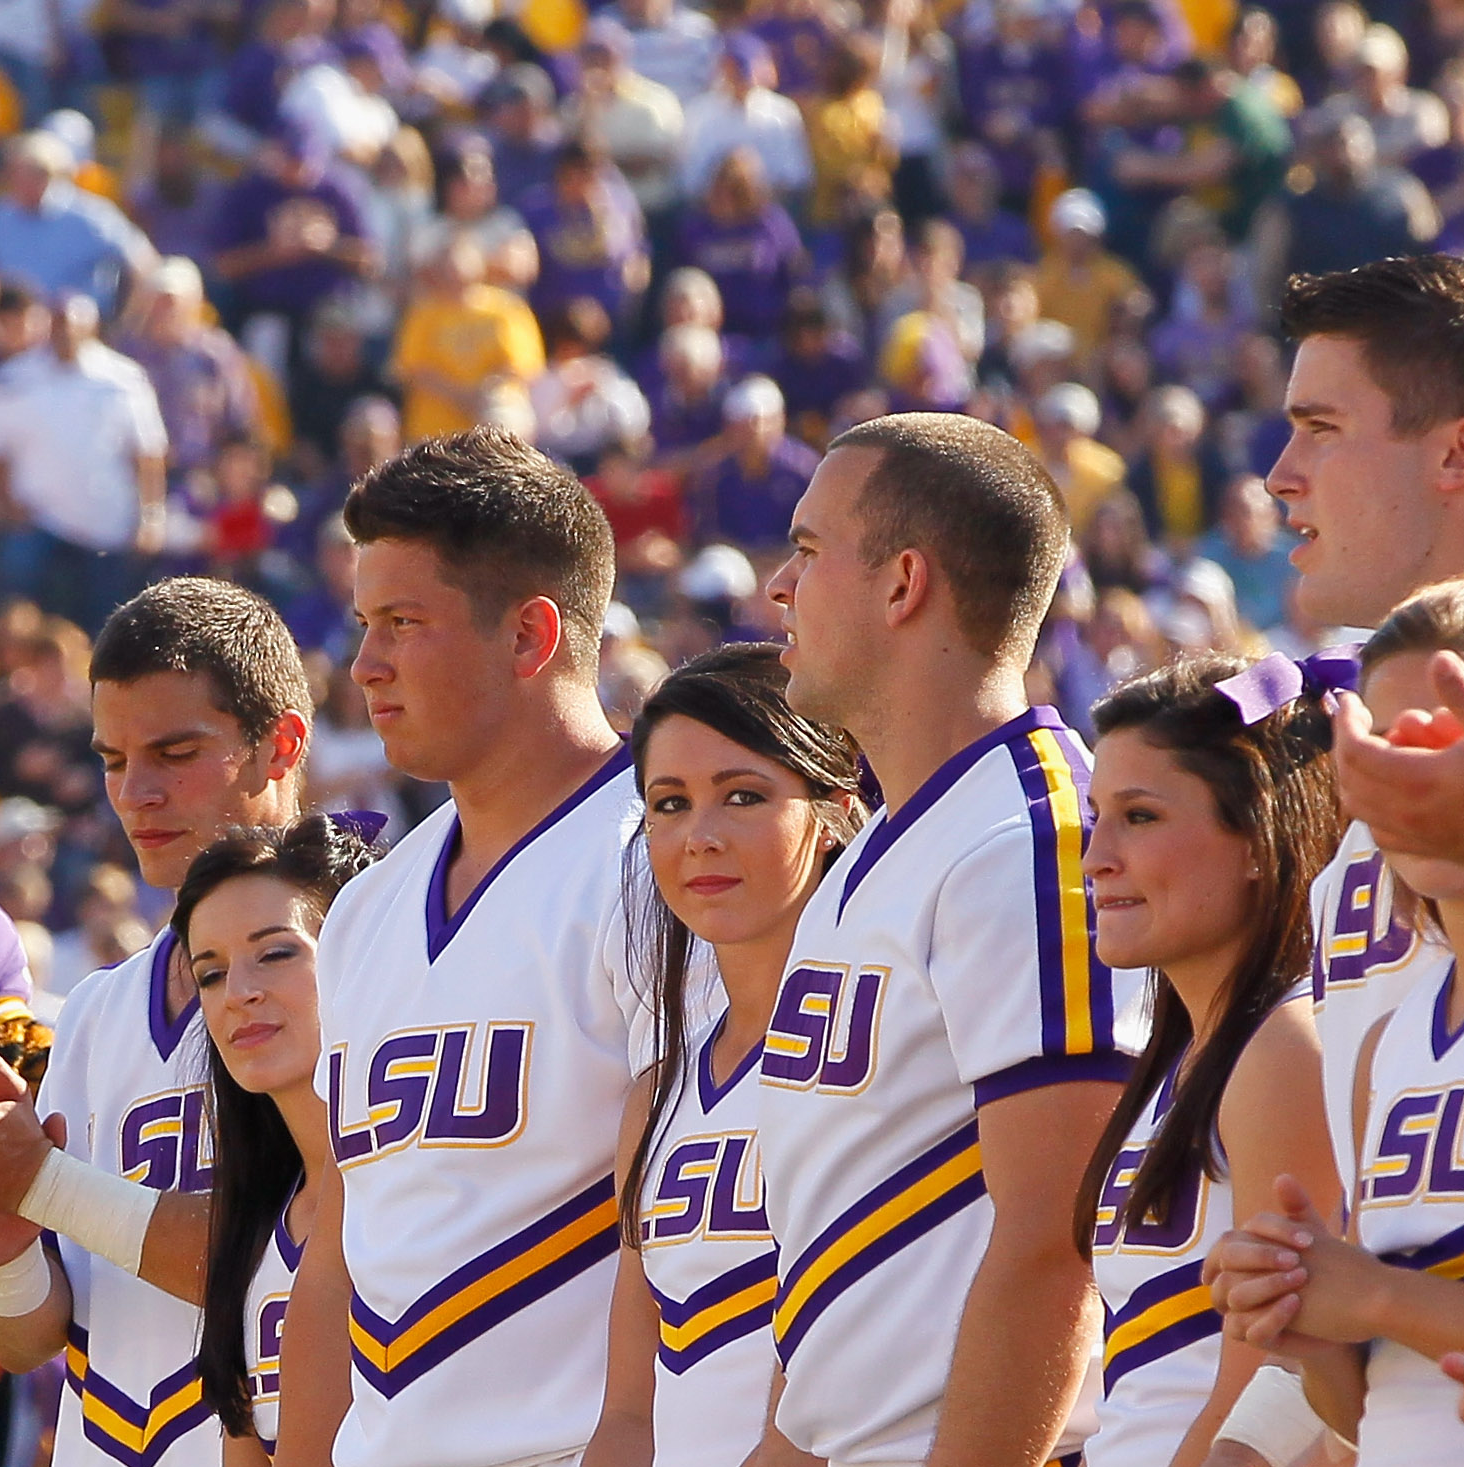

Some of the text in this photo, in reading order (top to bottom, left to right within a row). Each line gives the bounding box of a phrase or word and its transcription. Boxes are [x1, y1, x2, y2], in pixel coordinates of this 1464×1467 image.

[1313, 848, 1425, 1016] SU
[328, 1019, 536, 1173] LSU
[758, 960, 893, 1097] SU
[640, 1129, 776, 1250] SU
